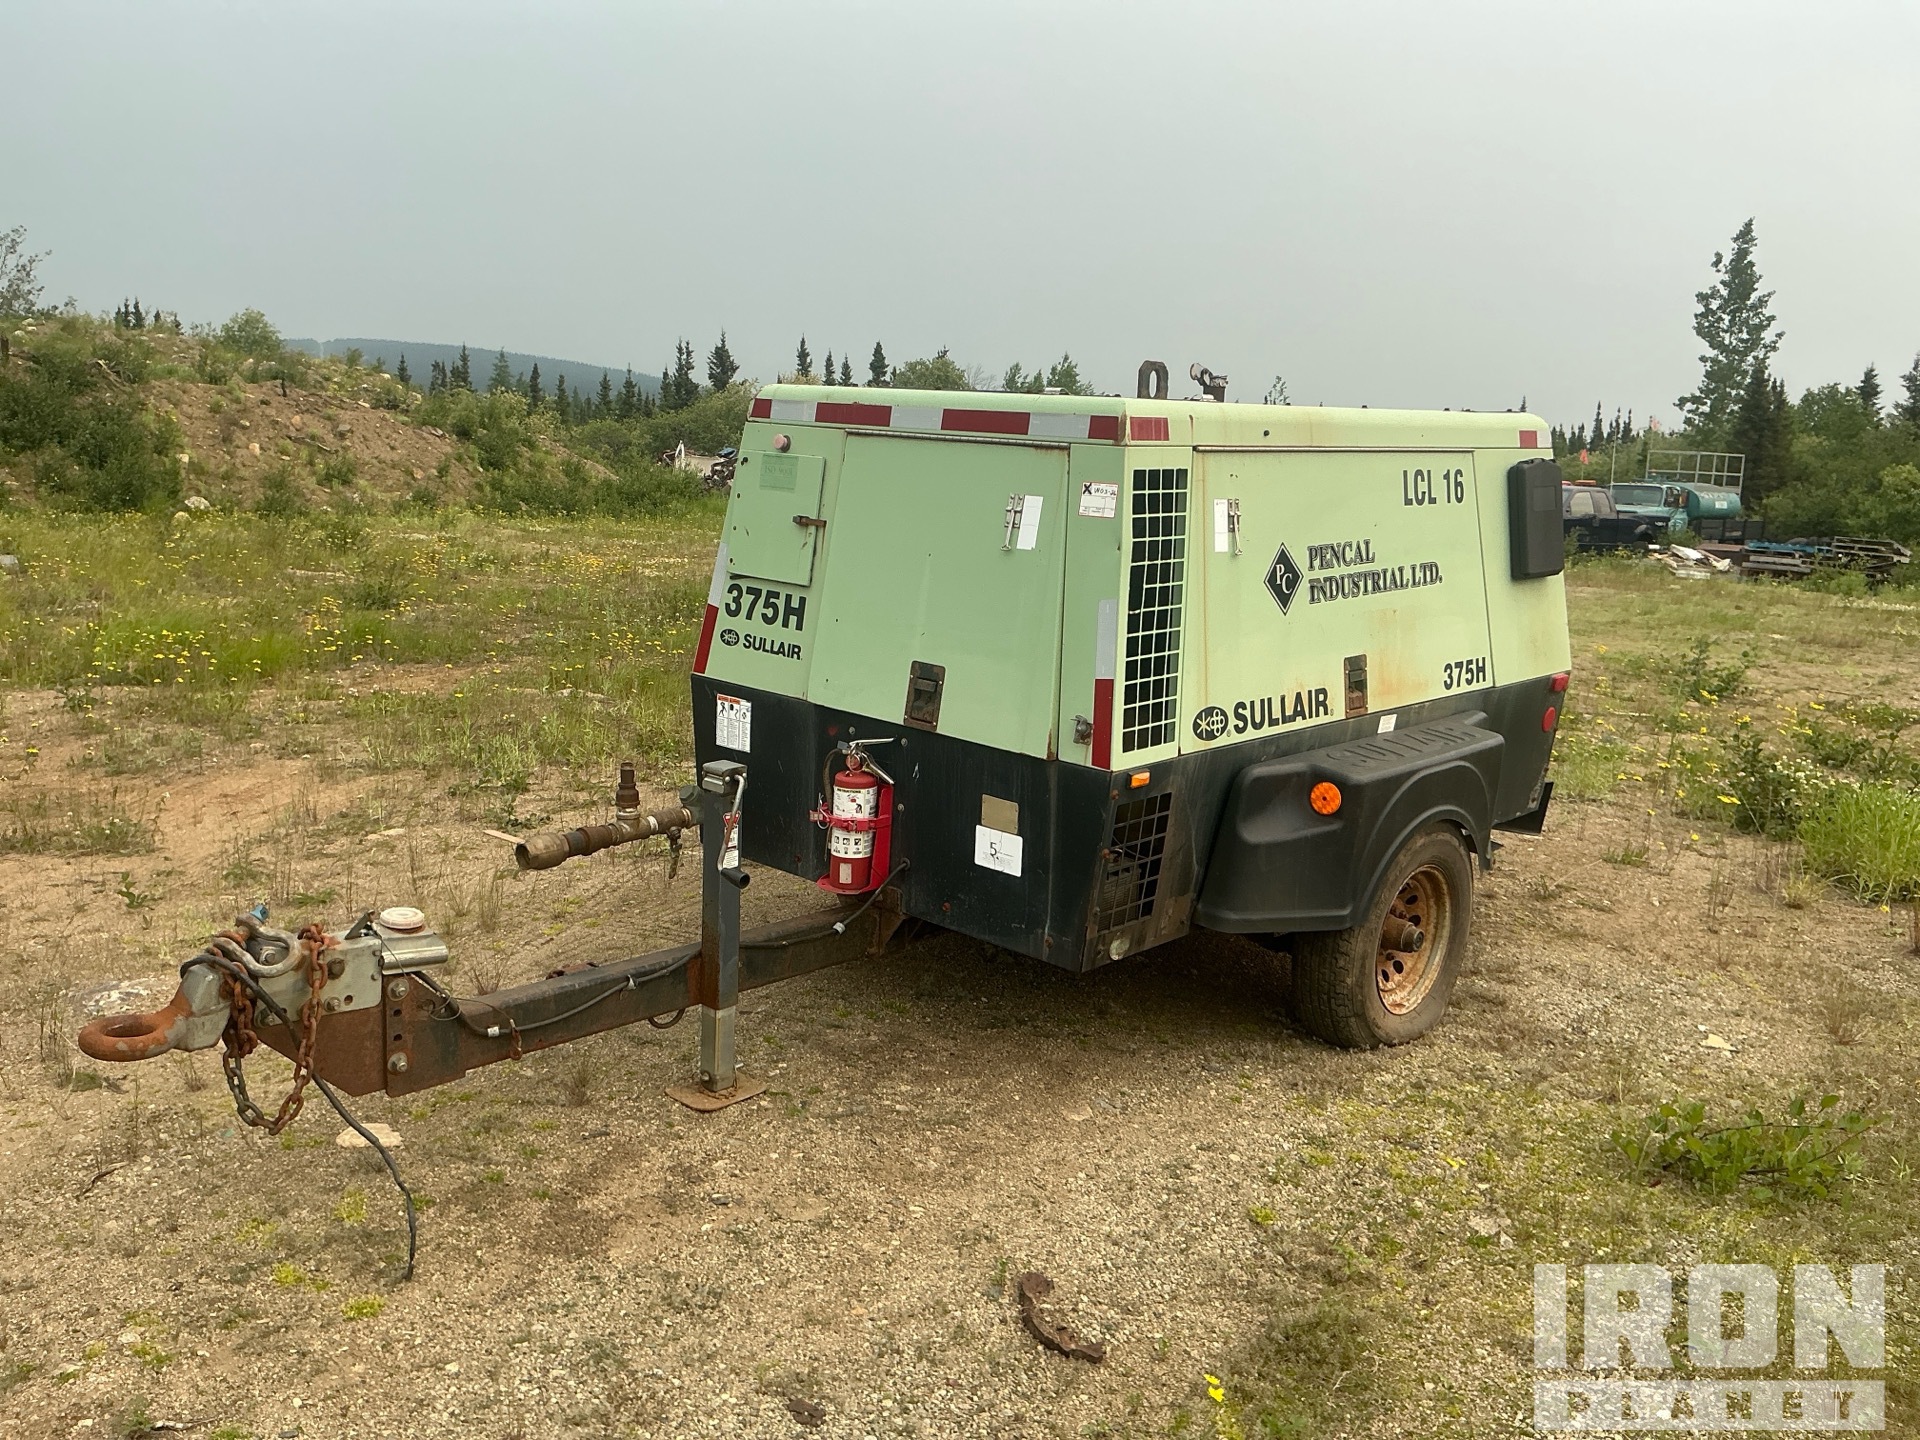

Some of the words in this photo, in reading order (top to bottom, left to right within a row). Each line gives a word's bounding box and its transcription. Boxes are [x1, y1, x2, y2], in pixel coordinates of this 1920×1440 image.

[1403, 469, 1437, 506] LCL
[1443, 469, 1464, 503] 16
[1307, 539, 1375, 571] PENCAL
[1275, 563, 1293, 594] PC
[1308, 566, 1410, 604] INDUSTRIAL
[1410, 561, 1443, 588] LTD.
[725, 583, 807, 632] 375H
[742, 633, 802, 661] SULLAIR
[1443, 656, 1486, 690] 375H
[1233, 687, 1329, 735] SULLAIR
